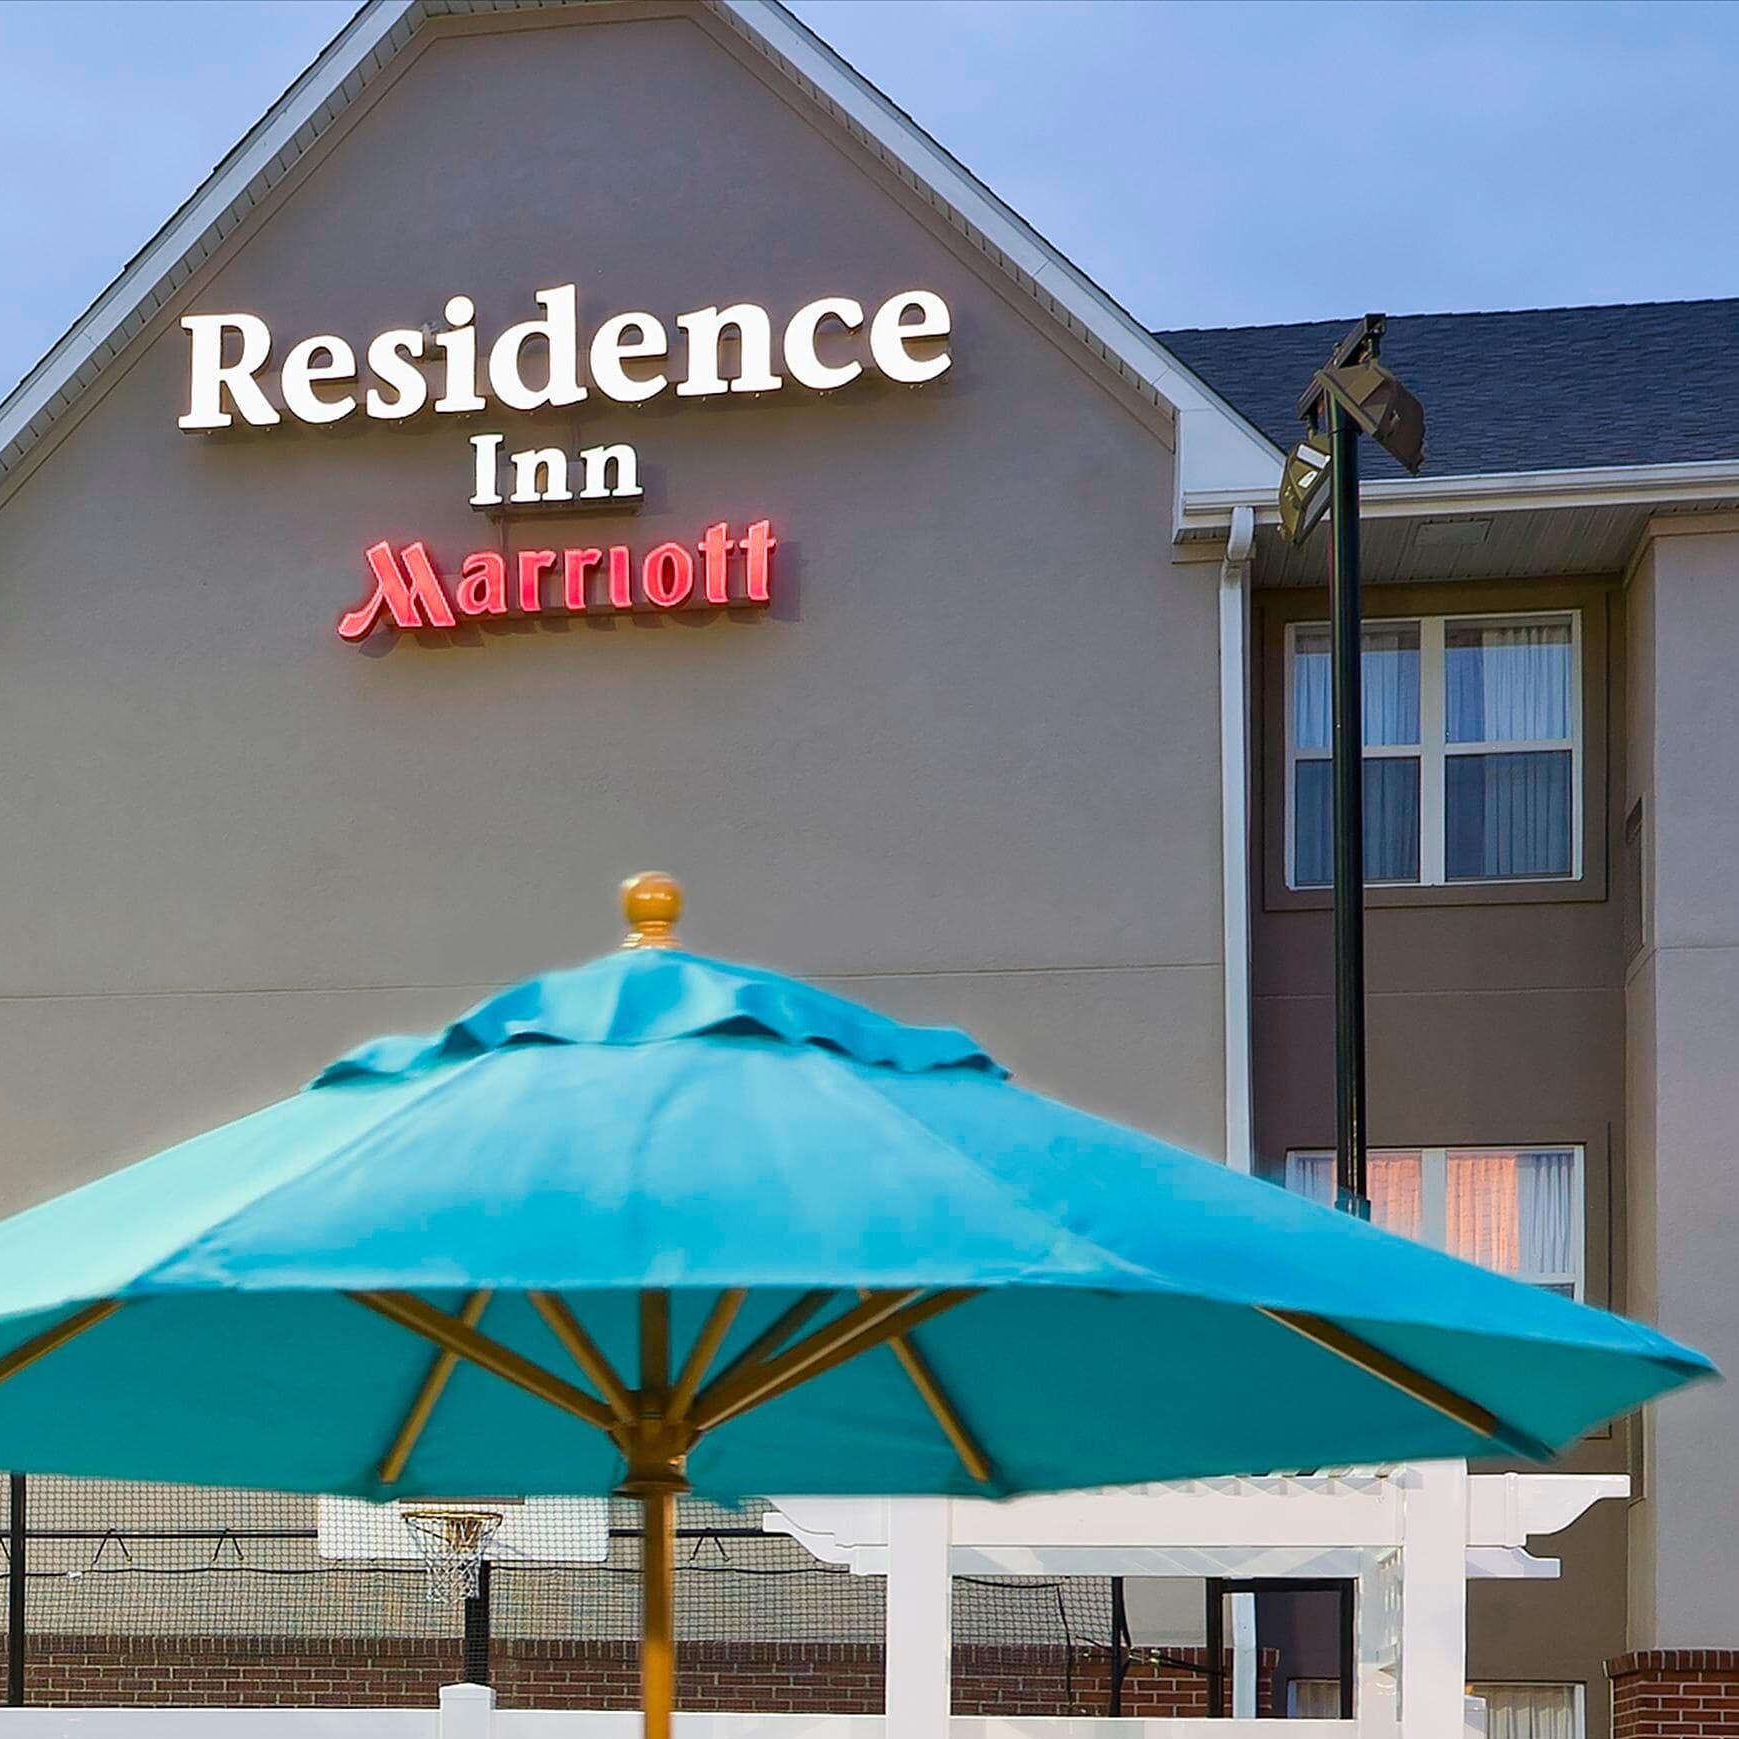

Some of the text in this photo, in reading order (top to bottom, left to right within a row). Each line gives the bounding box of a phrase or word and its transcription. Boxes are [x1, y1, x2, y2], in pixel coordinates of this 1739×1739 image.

[177, 284, 953, 429] Residence
[468, 434, 644, 505] Inn
[337, 519, 777, 639] Marriott
